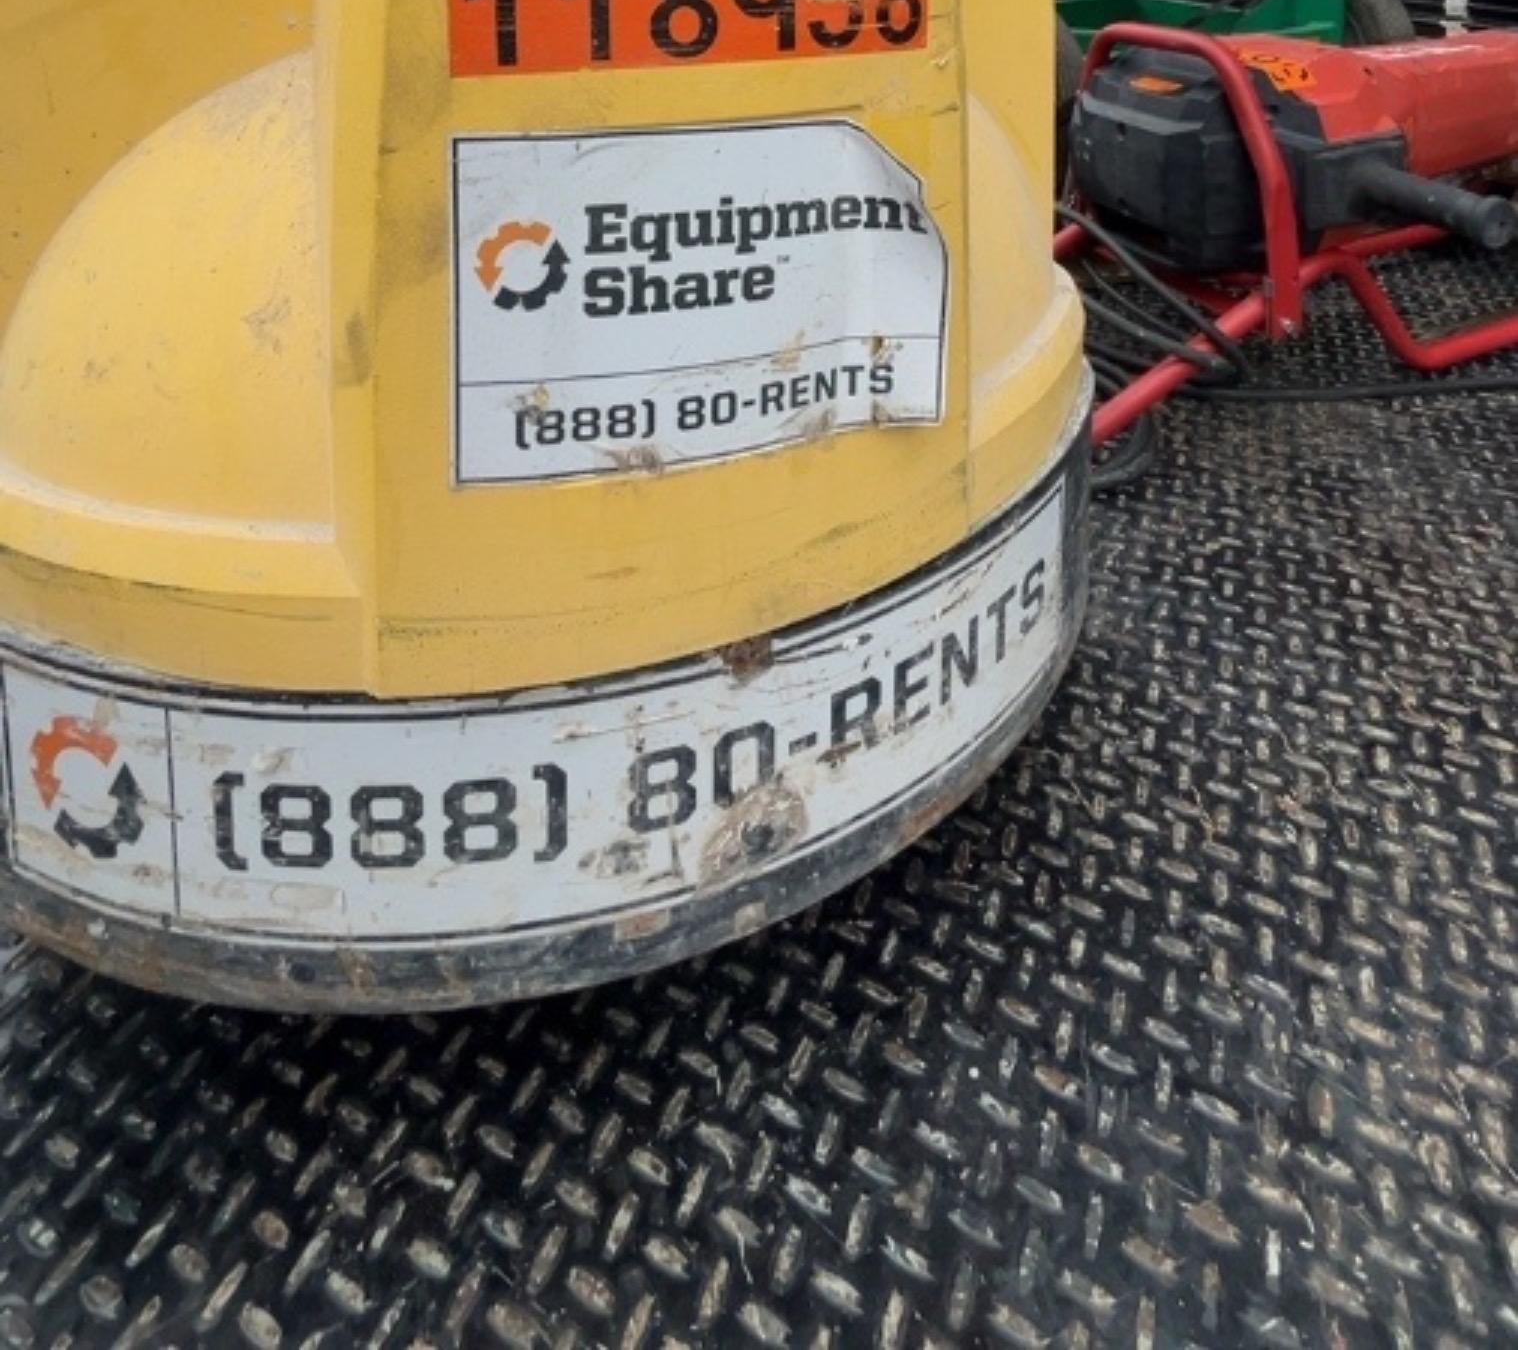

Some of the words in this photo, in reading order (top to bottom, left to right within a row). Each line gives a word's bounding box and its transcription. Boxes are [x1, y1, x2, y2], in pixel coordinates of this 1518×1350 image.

[584, 263, 775, 318] Share
[515, 400, 655, 449] (888)
[678, 365, 894, 431] 80-RENTS
[213, 762, 568, 871] (888)
[628, 558, 1046, 833] 80-RENTS
